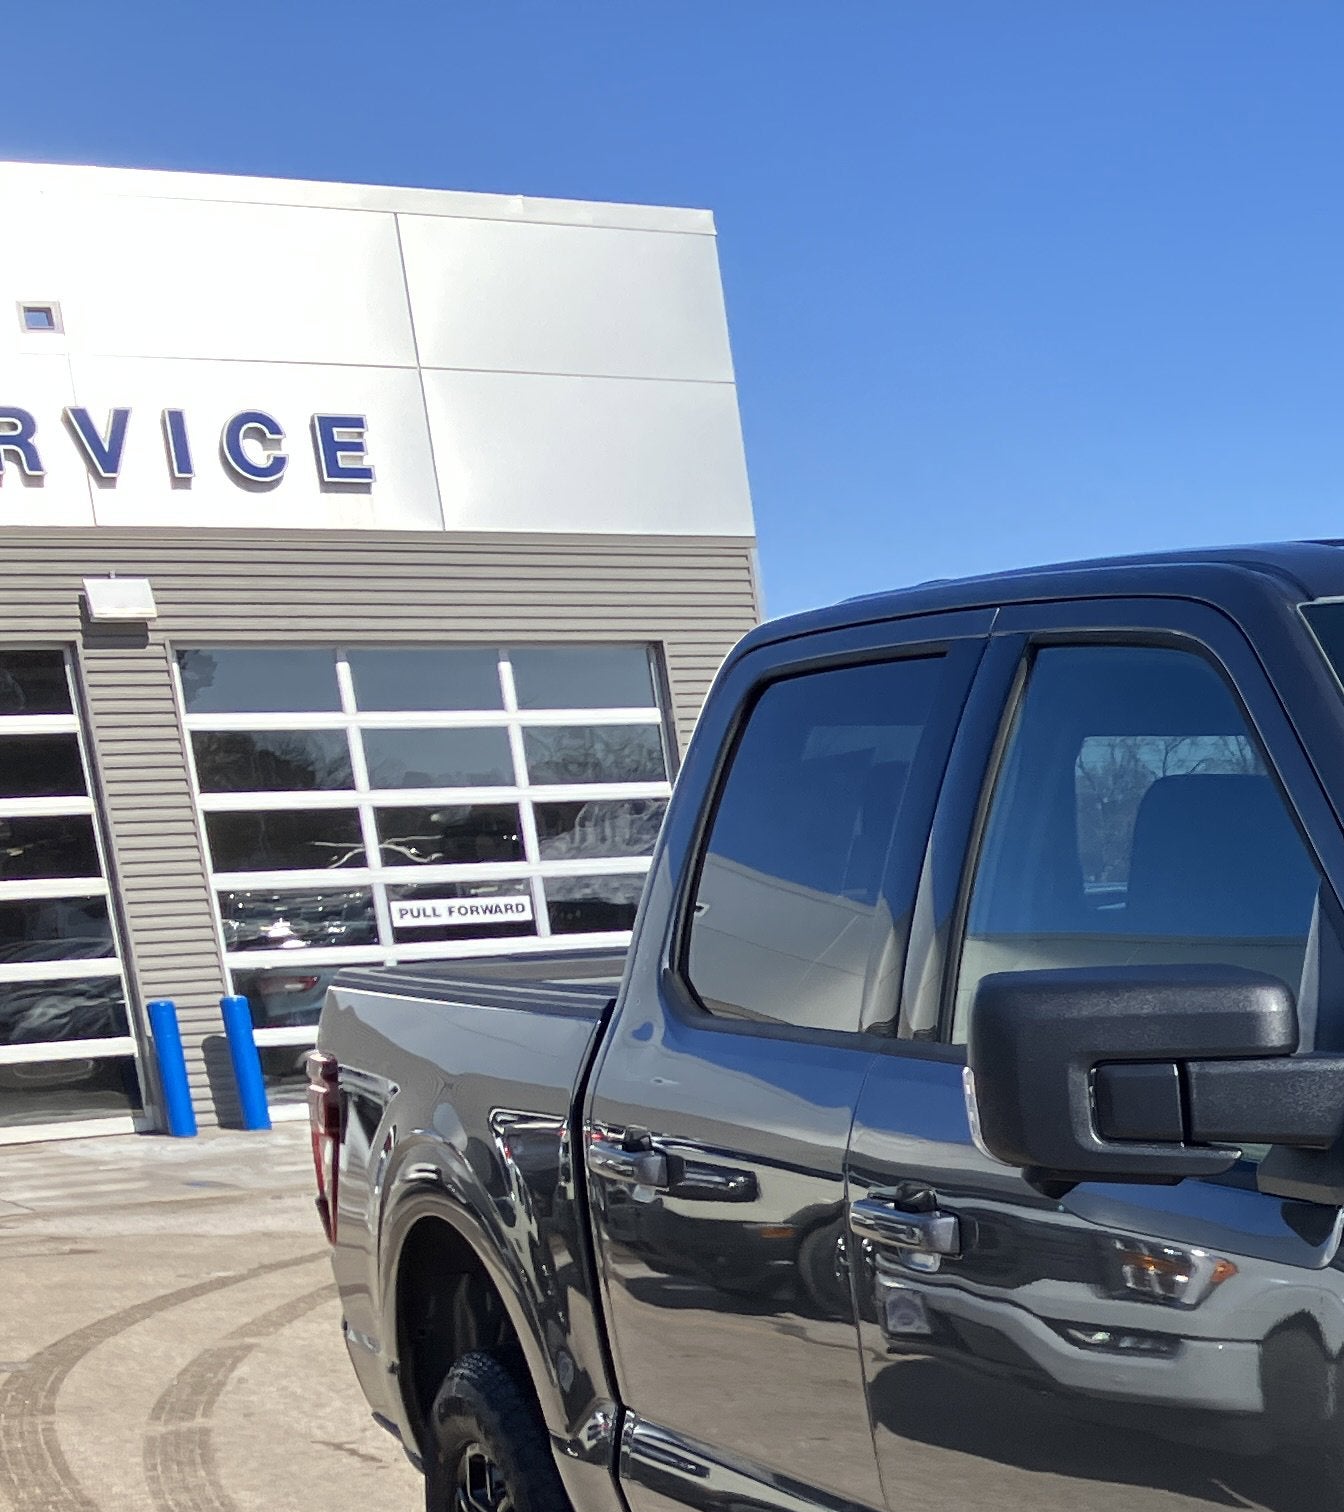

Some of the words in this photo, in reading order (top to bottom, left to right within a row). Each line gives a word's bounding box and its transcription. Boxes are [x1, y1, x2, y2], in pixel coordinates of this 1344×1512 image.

[0, 405, 376, 484] RVICE
[399, 906, 441, 919] PULL
[447, 902, 526, 917] FORWARD
